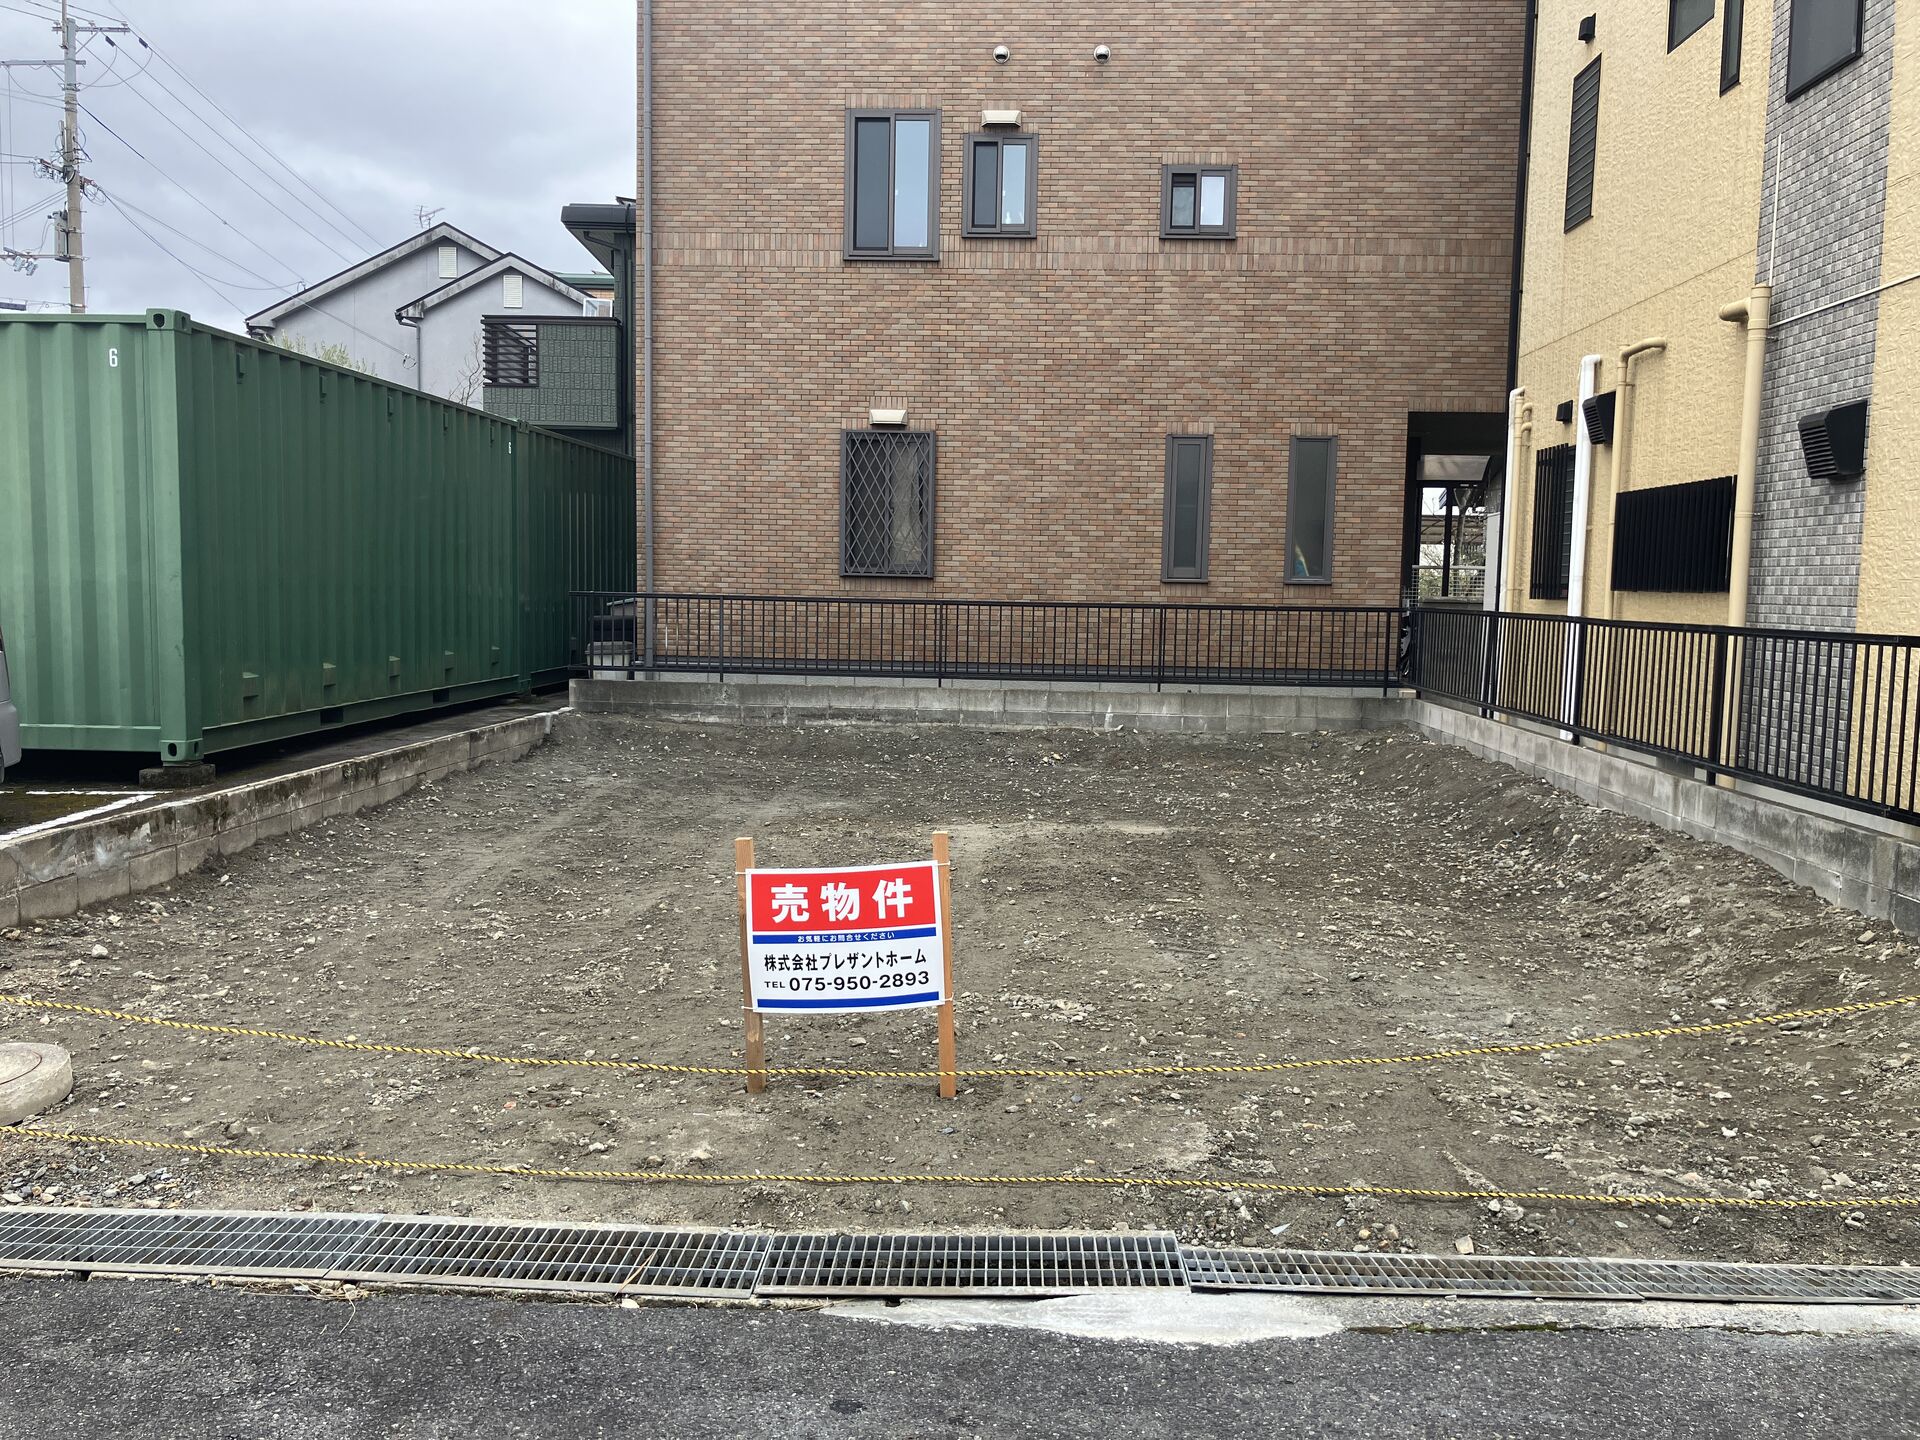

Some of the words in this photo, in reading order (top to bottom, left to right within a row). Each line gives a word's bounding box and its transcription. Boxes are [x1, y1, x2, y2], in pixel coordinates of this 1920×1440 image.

[109, 348, 118, 367] 6
[771, 878, 913, 923] 売物件
[797, 932, 895, 943] お気軽にお問合せください
[764, 949, 927, 971] 株式会社プレザントホーム
[789, 971, 929, 991] 075-950-2893
